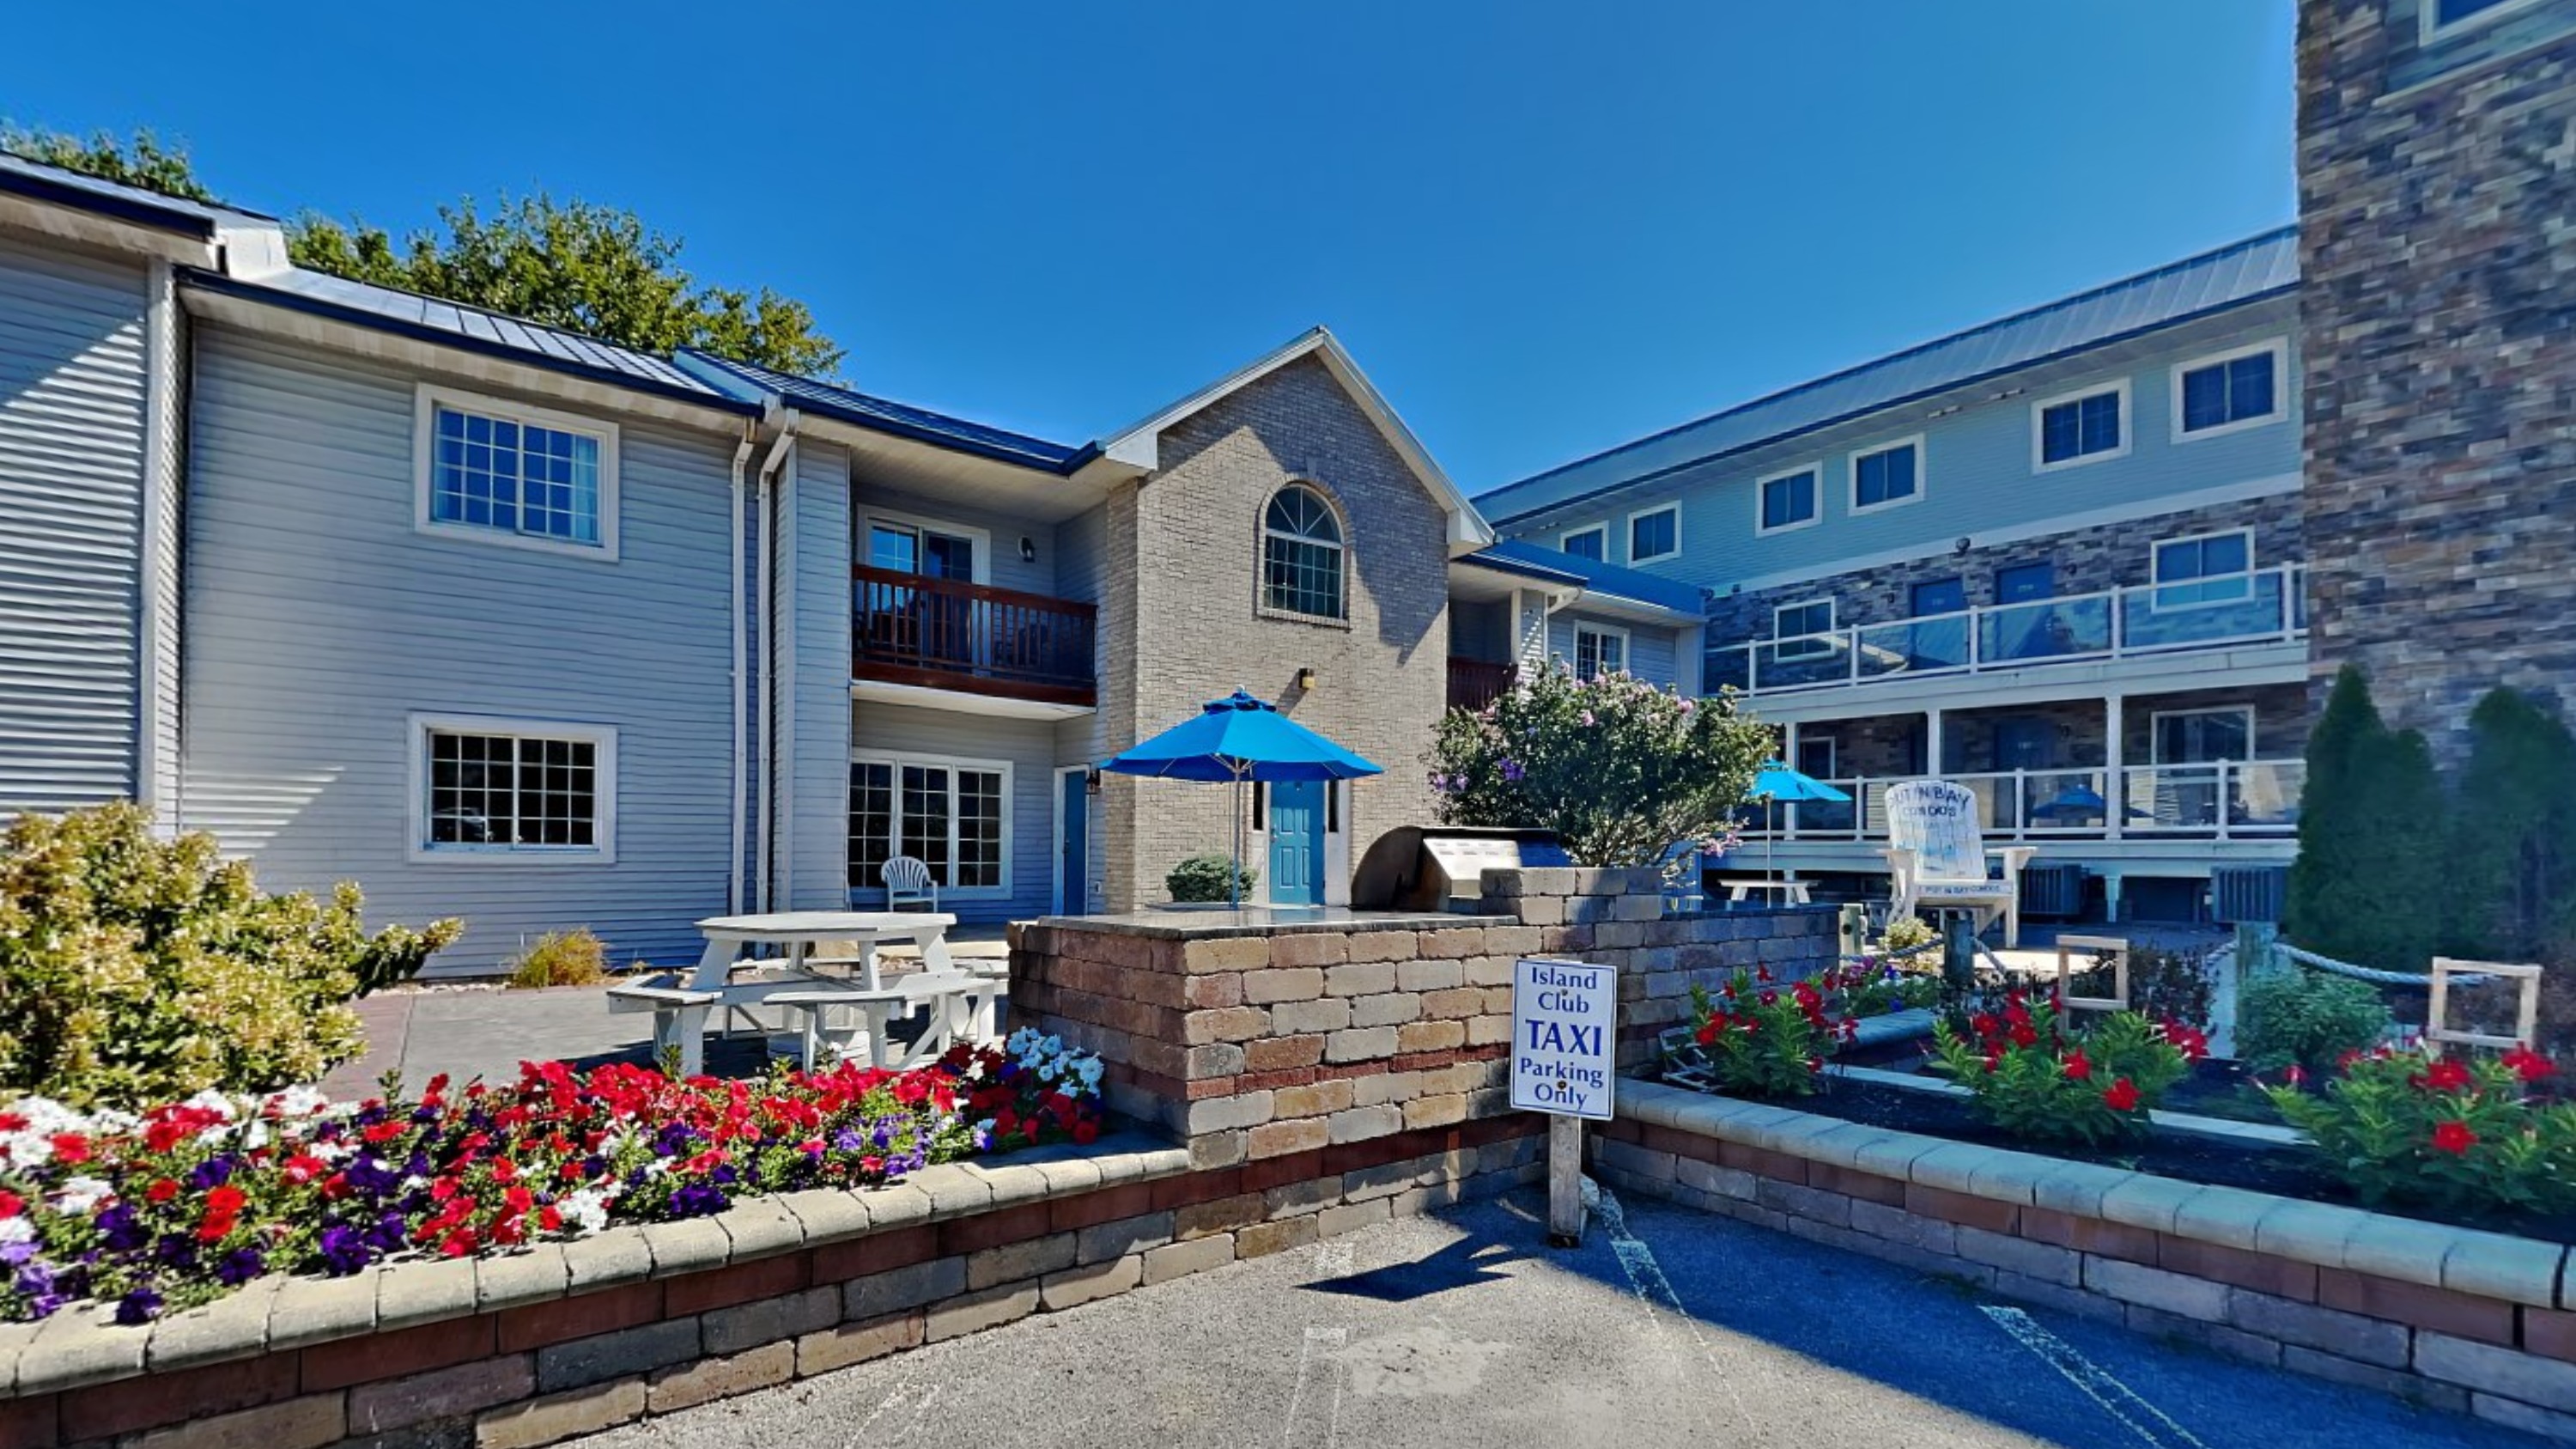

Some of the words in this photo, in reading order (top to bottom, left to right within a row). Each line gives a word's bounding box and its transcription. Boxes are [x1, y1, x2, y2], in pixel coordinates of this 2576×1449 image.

[1934, 785, 1971, 811] BAY
[1531, 966, 1597, 989] Island
[1538, 991, 1589, 1014] Club
[1525, 1018, 1601, 1056] TAXI
[1520, 1057, 1604, 1089] Parking
[1534, 1082, 1588, 1110] Only
